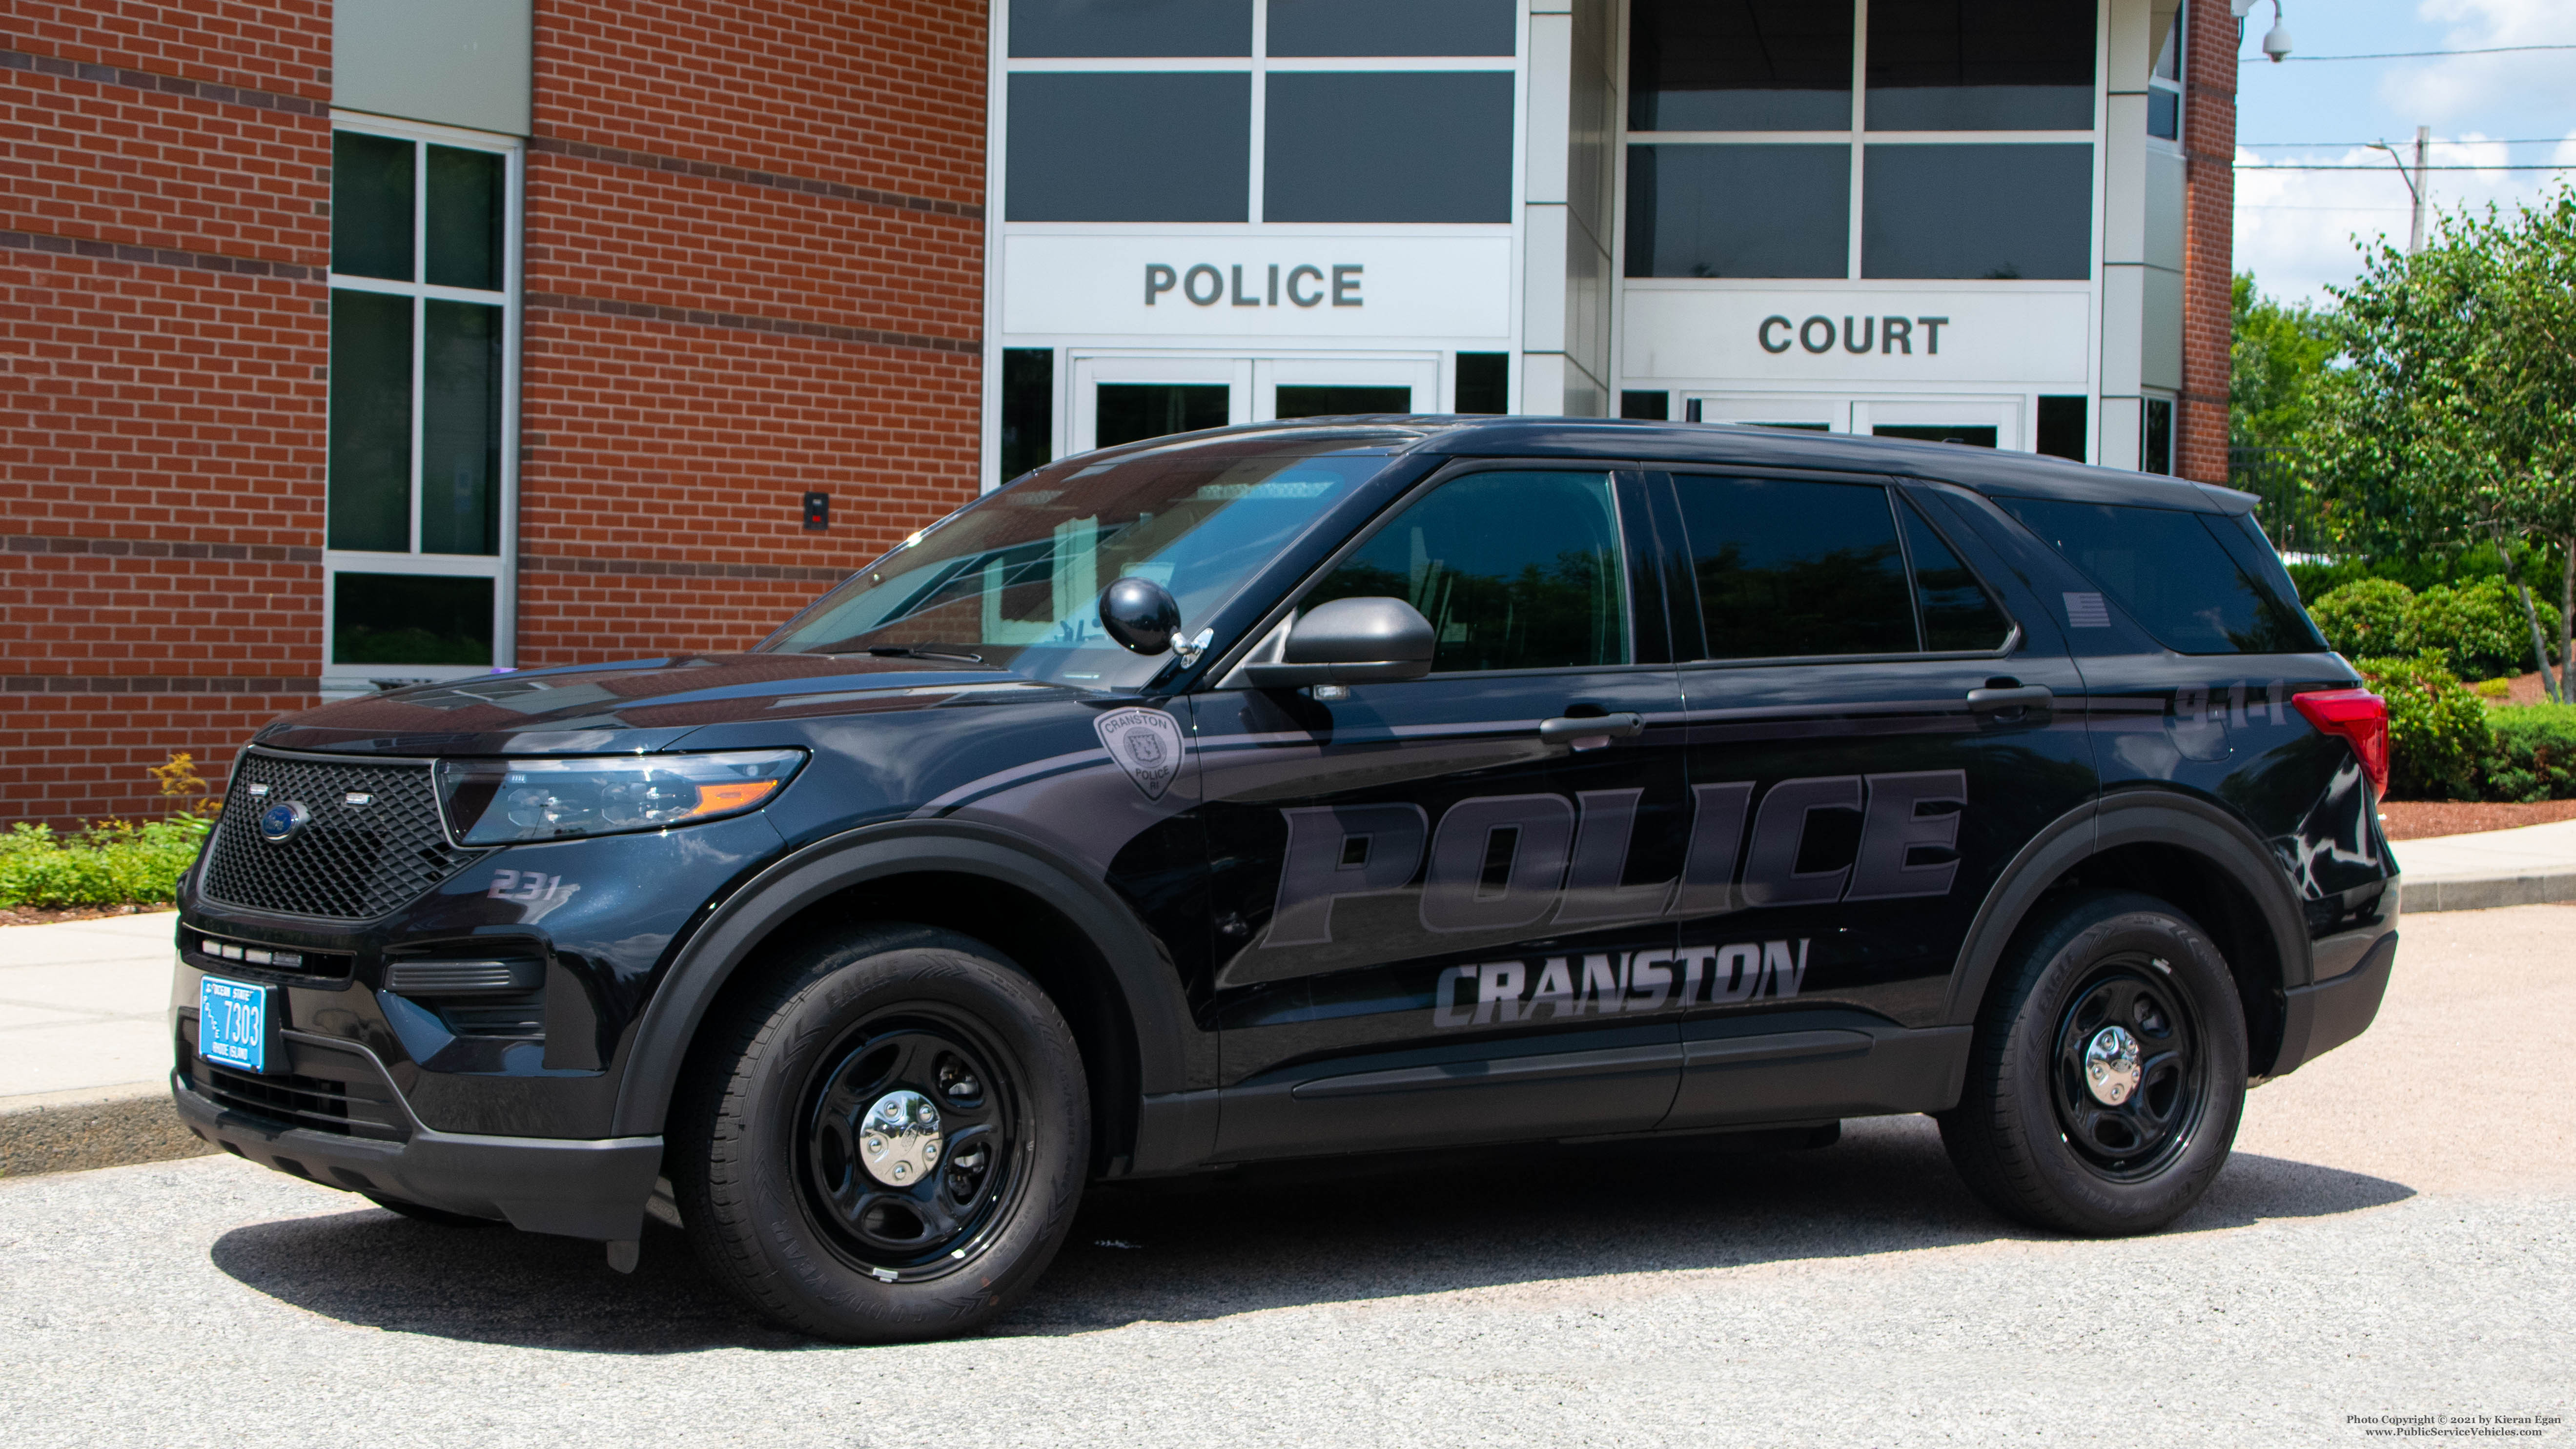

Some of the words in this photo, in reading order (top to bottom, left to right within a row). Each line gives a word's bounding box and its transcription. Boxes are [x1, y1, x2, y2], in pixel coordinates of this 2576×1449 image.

[1145, 263, 1364, 307] POLICE
[1758, 314, 1949, 355] COURT
[1104, 715, 1168, 733] CRANSTON
[1135, 766, 1169, 780] POLICE
[1150, 781, 1159, 790] RI
[1259, 768, 1968, 949] POLICE
[487, 869, 562, 900] 231
[1432, 938, 1810, 1029] CRANSTON
[224, 1000, 259, 1046] 7303
[212, 1041, 229, 1056] RHODE
[230, 1045, 248, 1061] ISLAND
